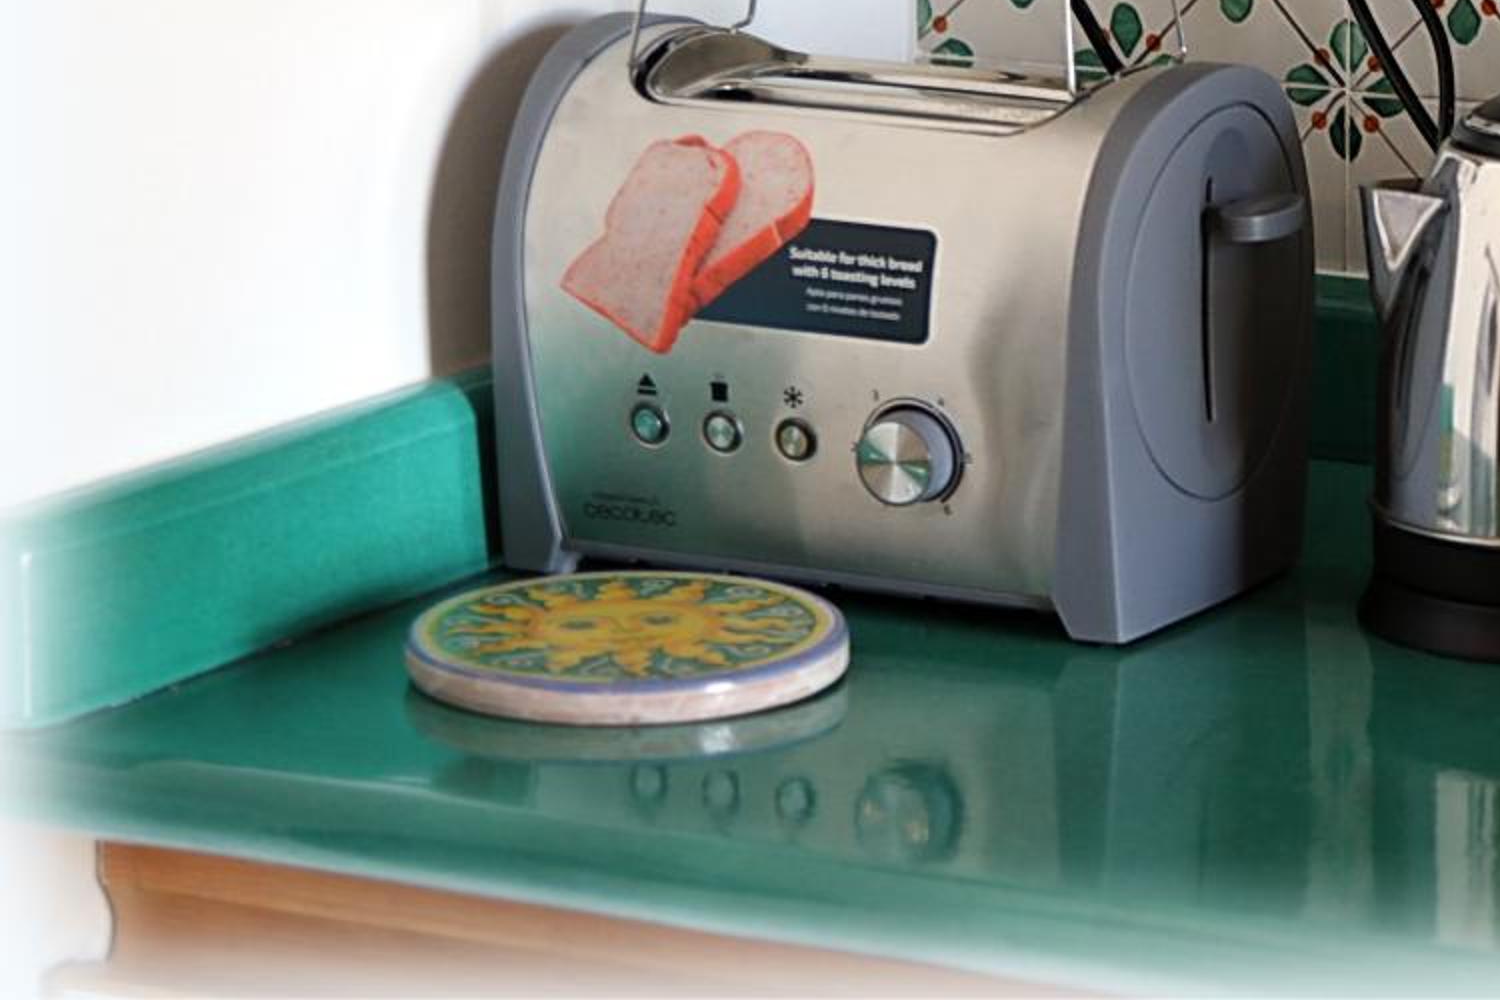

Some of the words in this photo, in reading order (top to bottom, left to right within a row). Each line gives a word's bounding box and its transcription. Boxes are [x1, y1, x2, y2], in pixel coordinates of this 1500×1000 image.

[789, 246, 837, 264] Suitable
[839, 252, 855, 265] for
[857, 253, 886, 269] thick
[792, 265, 819, 278] with
